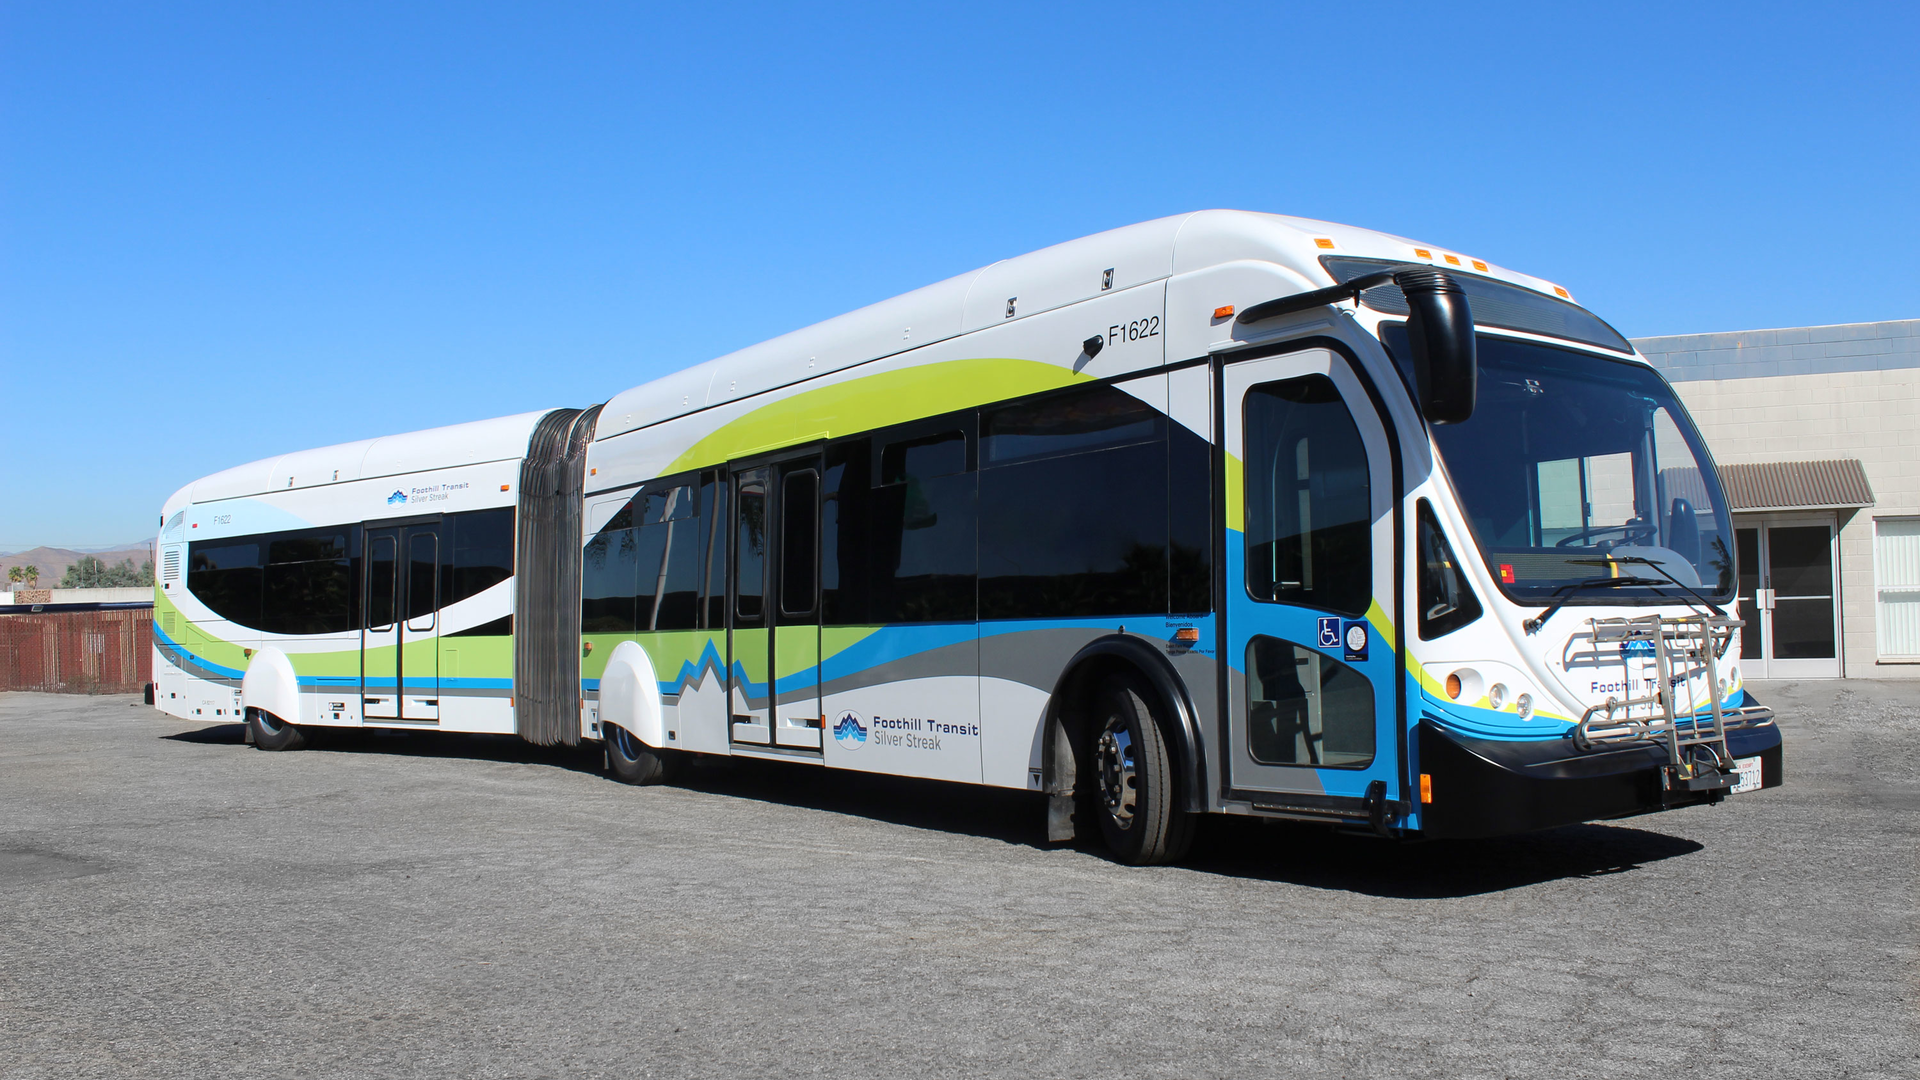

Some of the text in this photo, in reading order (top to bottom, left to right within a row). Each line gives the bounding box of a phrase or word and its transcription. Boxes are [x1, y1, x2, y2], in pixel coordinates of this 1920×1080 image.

[1108, 315, 1160, 347] F1622
[411, 482, 470, 495] Foothill Transit
[411, 492, 449, 504] Silver Streak
[213, 514, 232, 525] F1622
[1590, 679, 1639, 694] Foothill
[873, 716, 979, 736] Foothill Transit
[874, 730, 942, 750] Silver Streak
